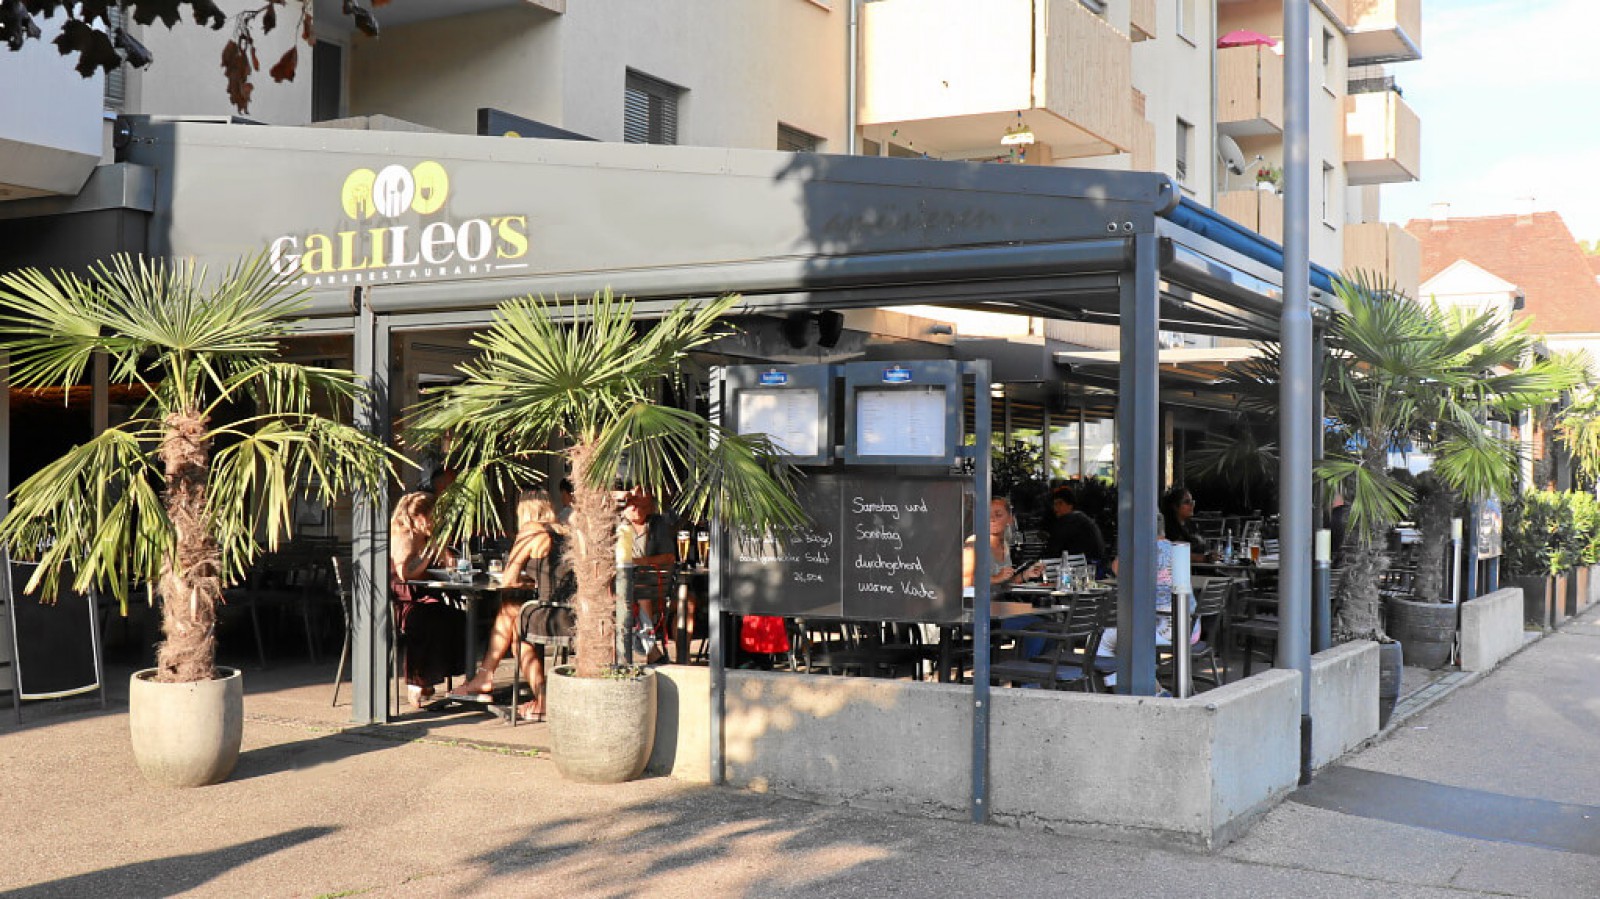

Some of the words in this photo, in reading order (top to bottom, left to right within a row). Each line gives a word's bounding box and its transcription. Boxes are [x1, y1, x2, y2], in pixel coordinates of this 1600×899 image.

[852, 496, 900, 520] Samstag
[905, 497, 929, 513] und
[854, 523, 903, 550] Sonntag
[855, 552, 925, 576] durchgehend
[858, 581, 894, 594] warme
